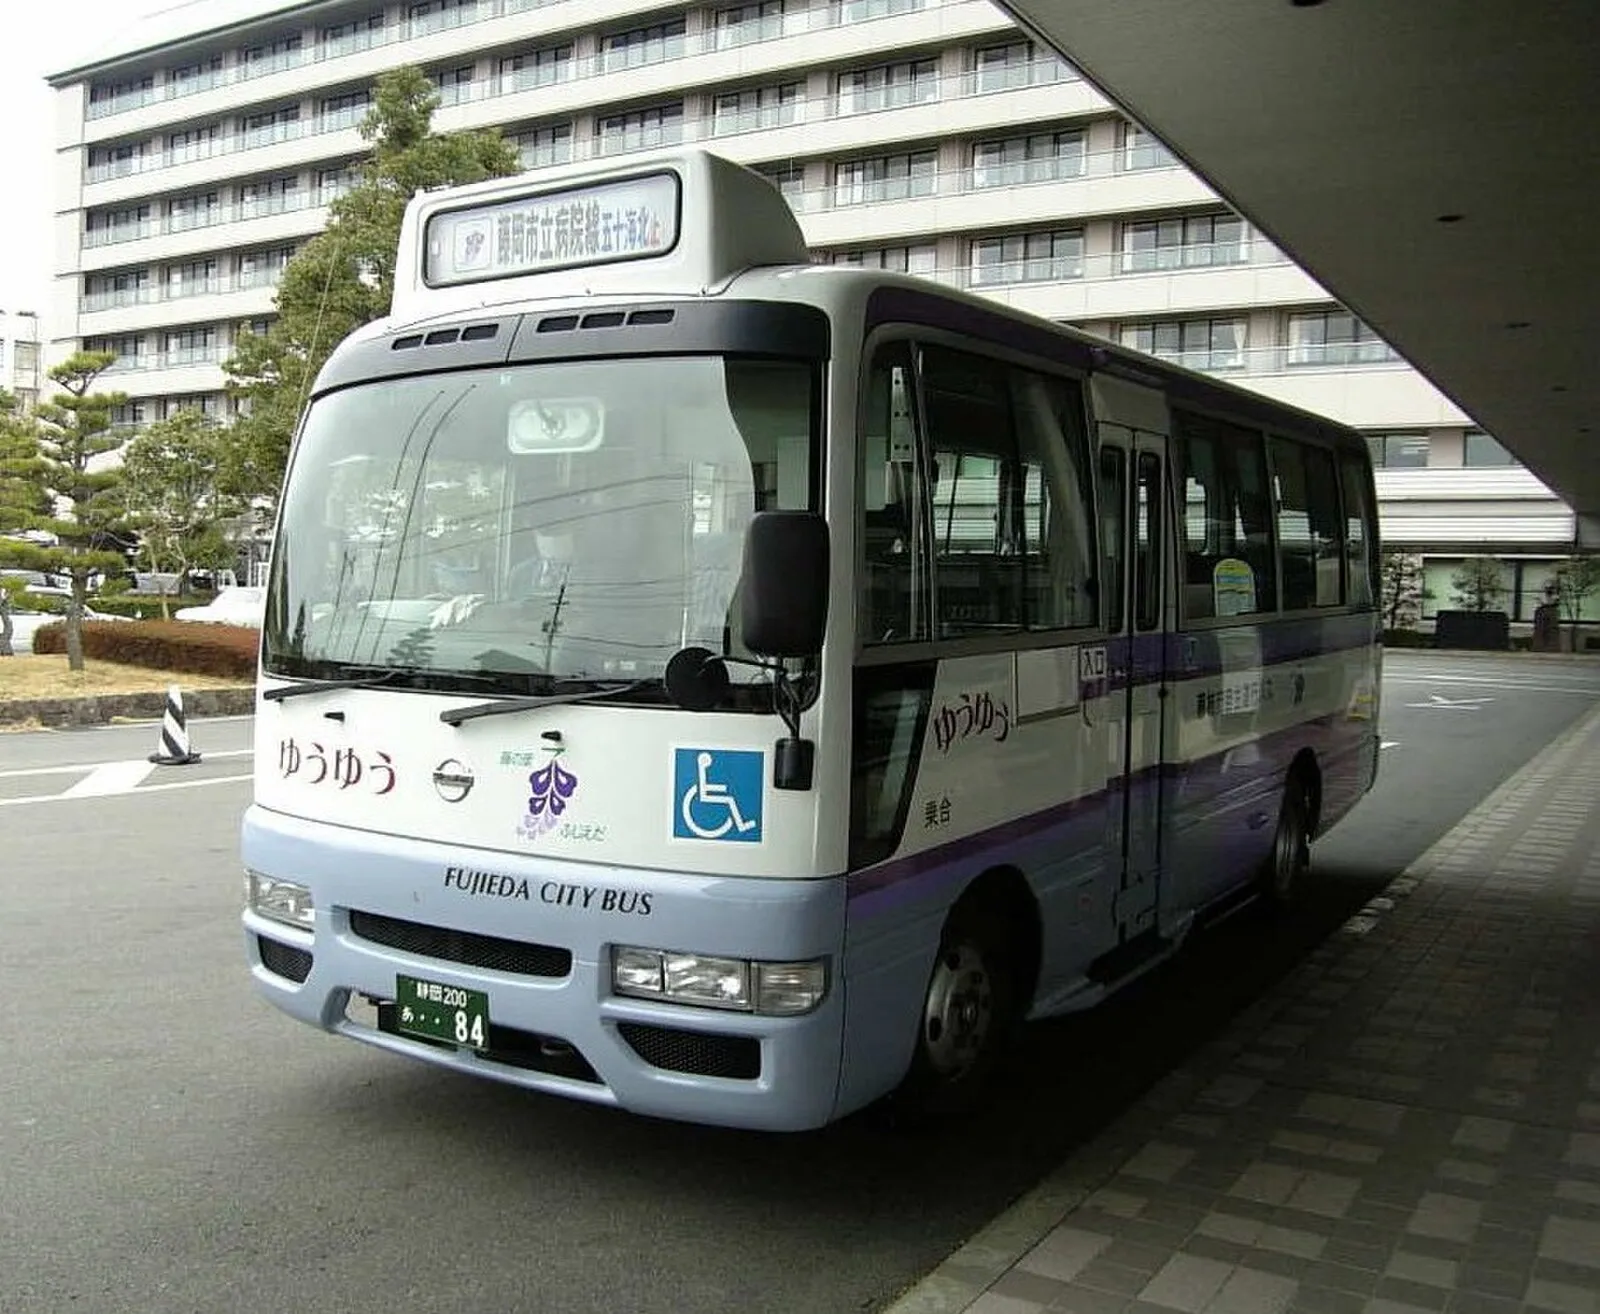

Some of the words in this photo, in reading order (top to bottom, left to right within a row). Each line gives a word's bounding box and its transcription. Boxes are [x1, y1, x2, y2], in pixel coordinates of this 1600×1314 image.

[1082, 650, 1104, 675] 入口
[933, 692, 1010, 752] ゆうゆう
[279, 737, 396, 795] ゆうゆう
[444, 867, 530, 900] FUJIEDA
[540, 881, 597, 909] CITY
[601, 889, 653, 916] BUS
[443, 987, 467, 1008] 200
